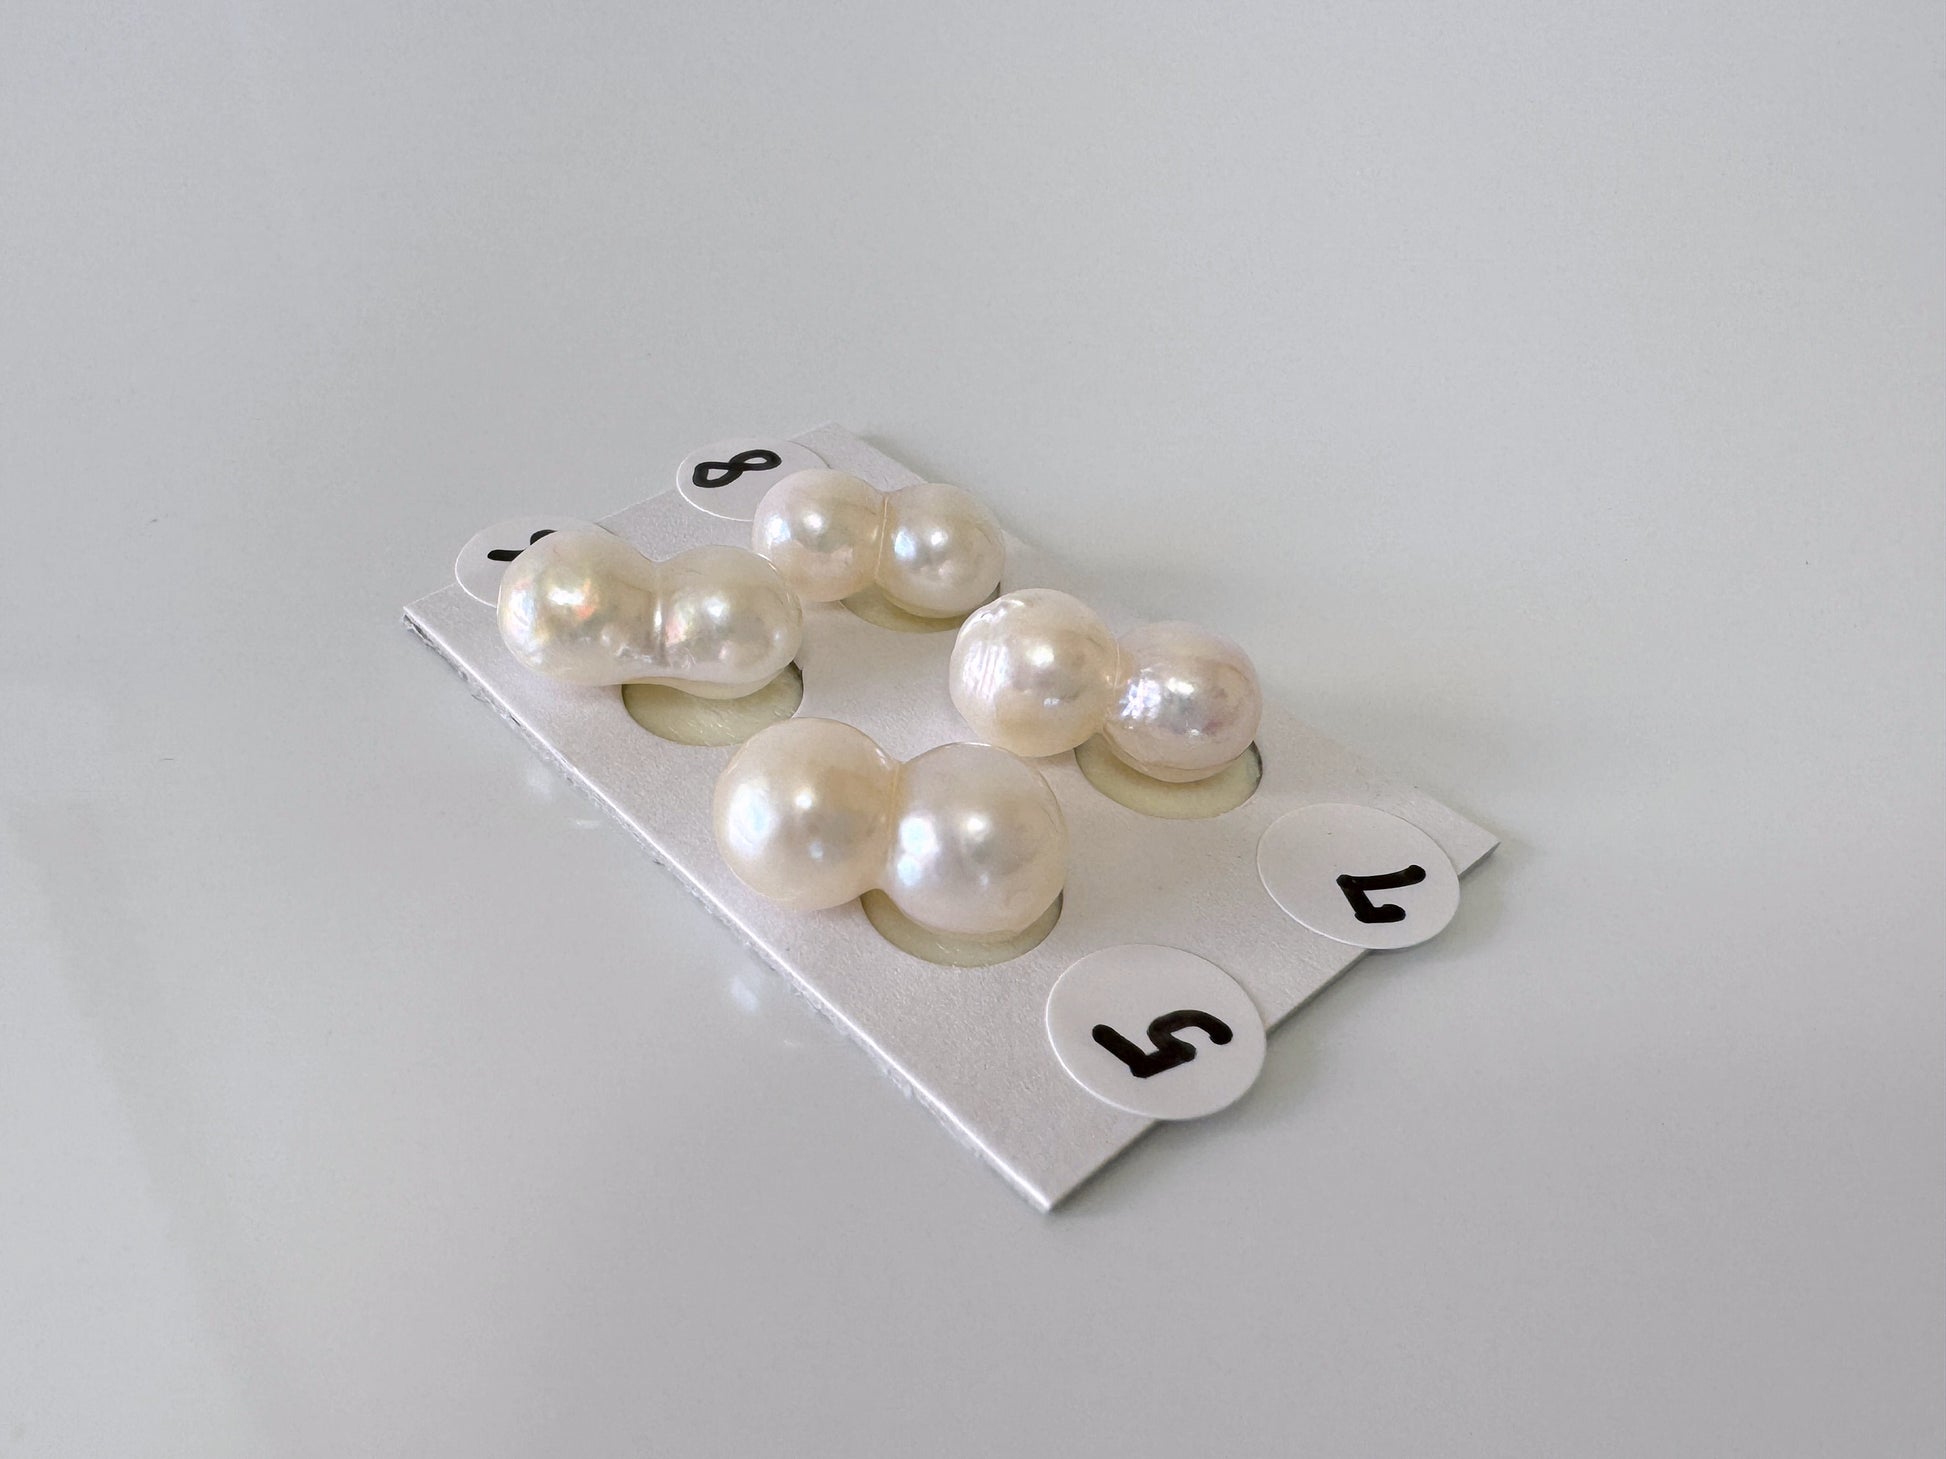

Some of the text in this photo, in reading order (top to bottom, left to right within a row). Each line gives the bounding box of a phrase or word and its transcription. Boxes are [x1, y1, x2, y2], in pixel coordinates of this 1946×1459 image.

[692, 449, 782, 488] 8
[1336, 864, 1427, 924] 7
[1092, 1009, 1234, 1079] 5
